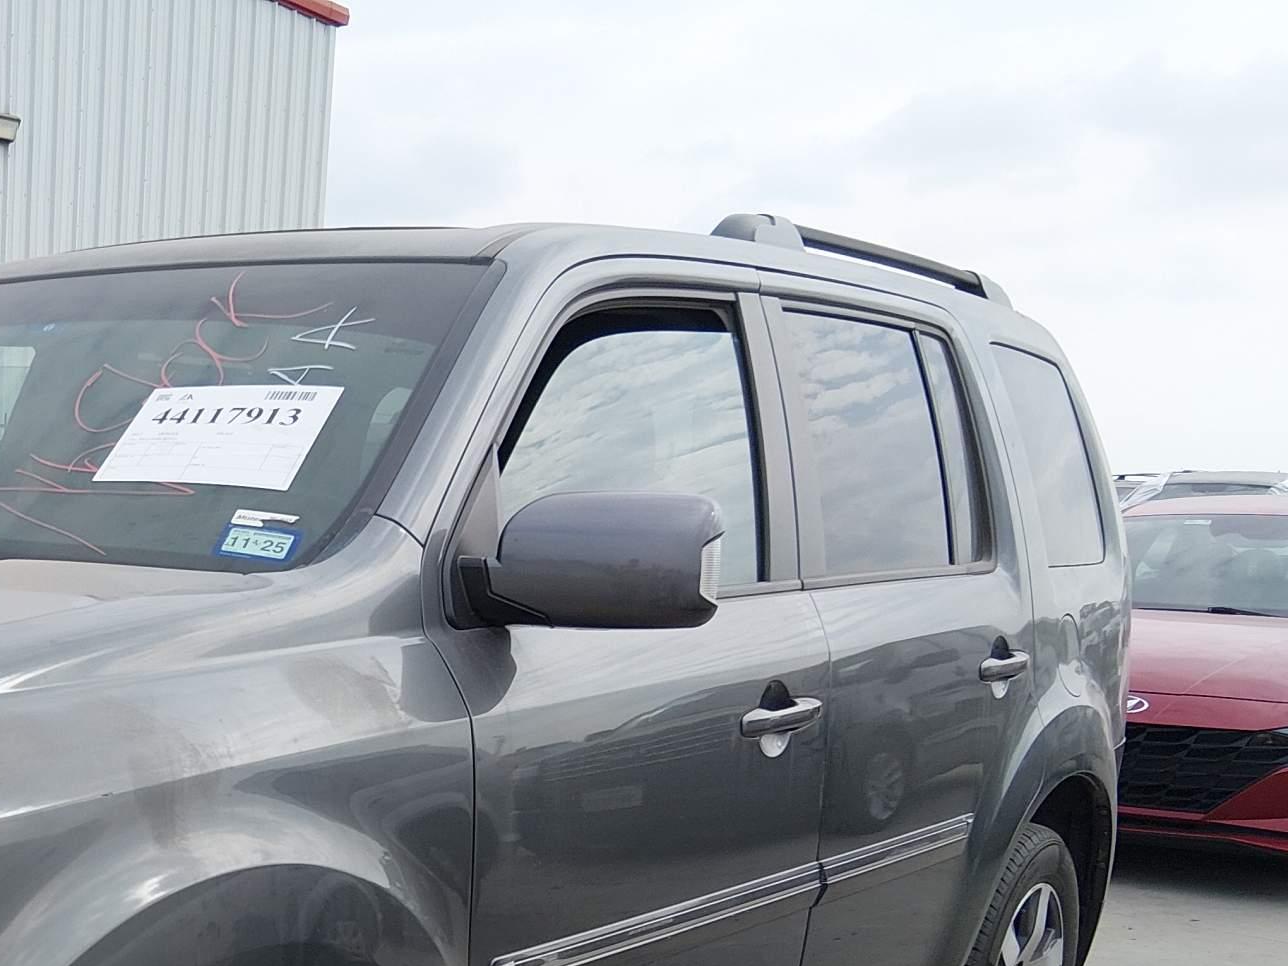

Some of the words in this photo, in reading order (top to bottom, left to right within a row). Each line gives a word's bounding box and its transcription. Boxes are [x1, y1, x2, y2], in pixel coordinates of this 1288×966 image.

[151, 406, 302, 426] 44117913
[224, 535, 251, 550] 11
[260, 539, 288, 554] 25
